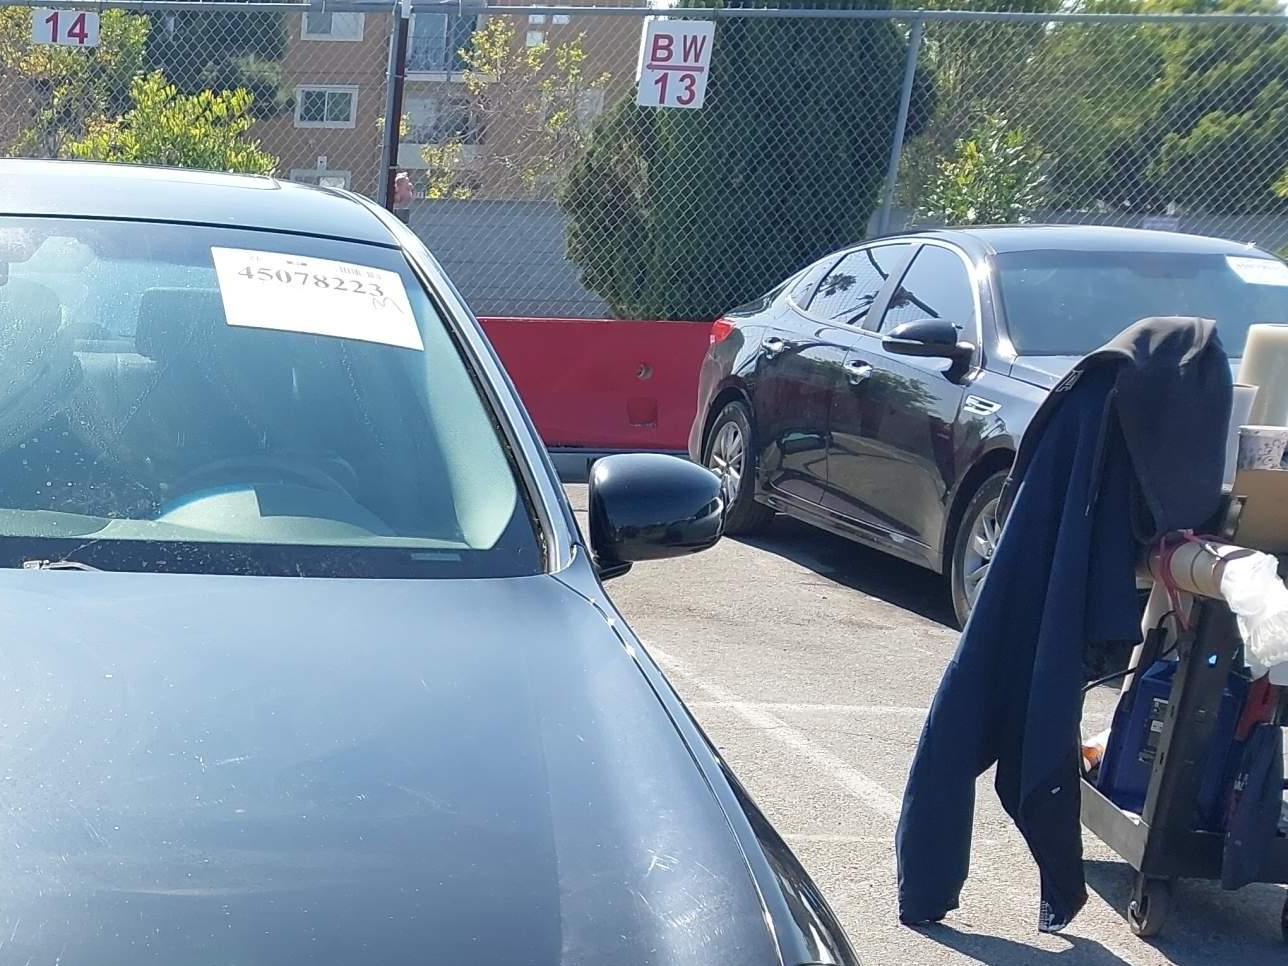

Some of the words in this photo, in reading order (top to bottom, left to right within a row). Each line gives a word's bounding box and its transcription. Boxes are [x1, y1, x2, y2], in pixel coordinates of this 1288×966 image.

[45, 11, 89, 45] 14
[654, 72, 697, 105] 13
[238, 265, 385, 297] 45078223
